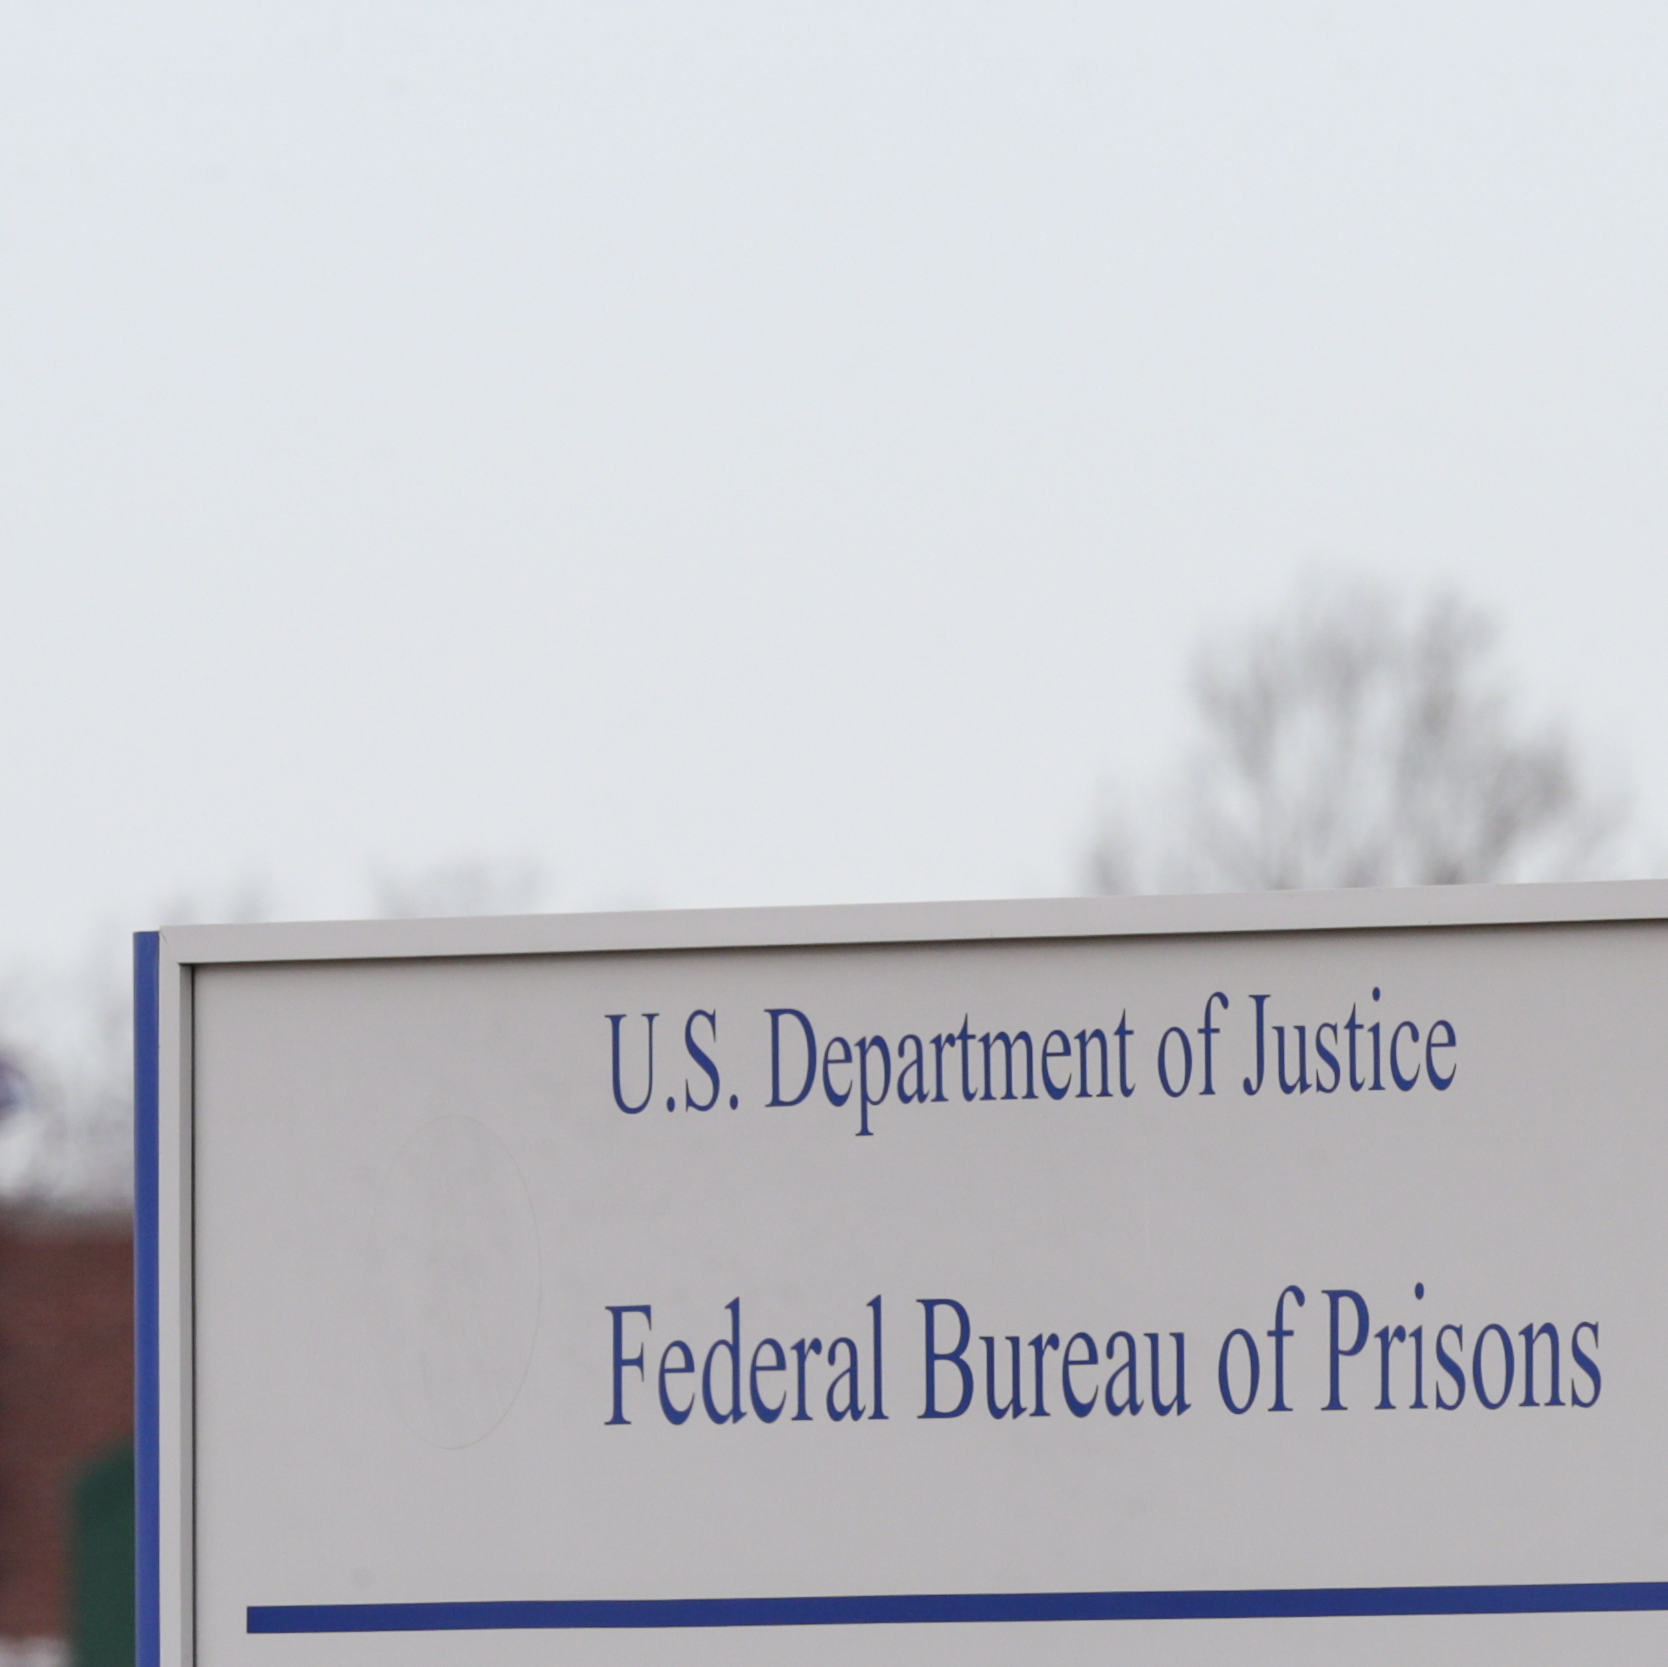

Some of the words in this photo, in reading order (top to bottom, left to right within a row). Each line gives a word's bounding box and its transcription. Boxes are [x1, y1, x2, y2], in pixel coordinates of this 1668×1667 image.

[603, 1008, 739, 1115] U.S.
[763, 1007, 1136, 1137] Department
[1156, 990, 1230, 1099] of
[1242, 986, 1457, 1097] Justice
[603, 1293, 890, 1426] Federal
[915, 1297, 1193, 1422] Bureau
[1217, 1284, 1306, 1416] of
[1320, 1281, 1602, 1412] Prisons
